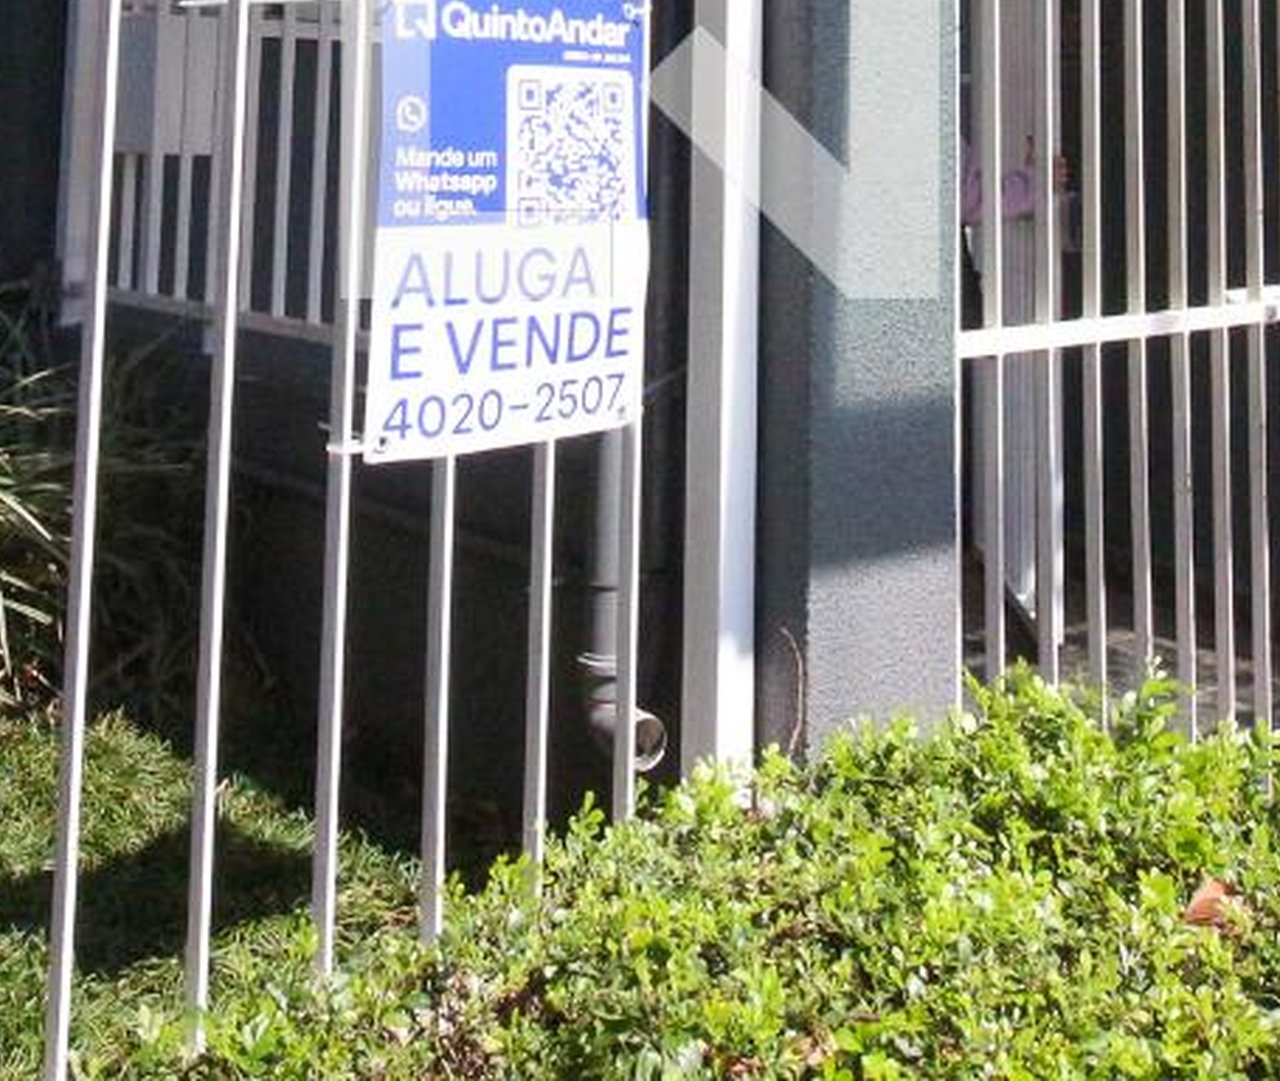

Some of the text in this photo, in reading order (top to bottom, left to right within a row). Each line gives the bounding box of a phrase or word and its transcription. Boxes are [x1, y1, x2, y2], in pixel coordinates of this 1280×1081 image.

[441, 0, 630, 47] QuintoAndar
[395, 146, 498, 168] Mande um
[393, 200, 422, 218] ou
[391, 246, 597, 309] ALUGA
[389, 306, 633, 380] E VENDE
[381, 372, 626, 439] 4020-2507
